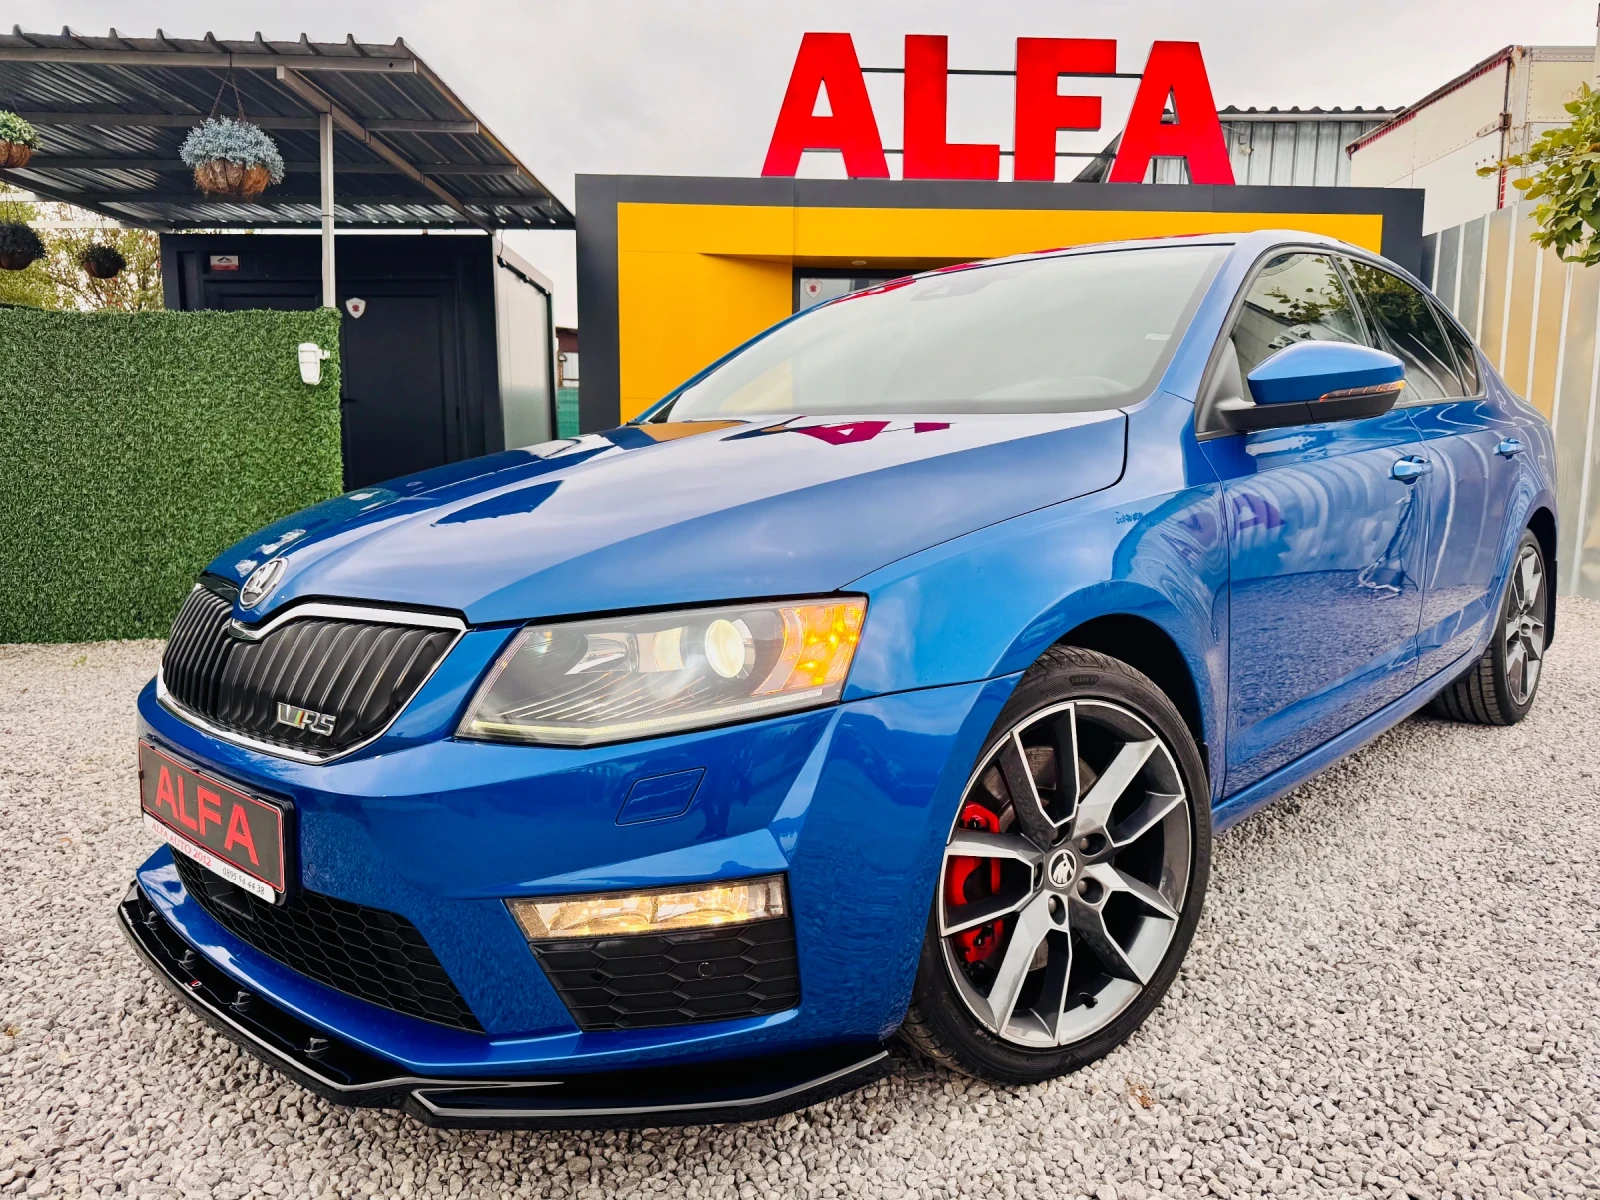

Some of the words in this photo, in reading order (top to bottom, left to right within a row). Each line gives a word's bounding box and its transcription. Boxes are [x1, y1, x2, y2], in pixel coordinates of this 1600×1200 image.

[761, 33, 1235, 185] ALFA
[151, 822, 169, 840] ALFA
[169, 834, 192, 854] AUTO
[193, 848, 212, 867] 2012
[155, 764, 260, 867] ALFA
